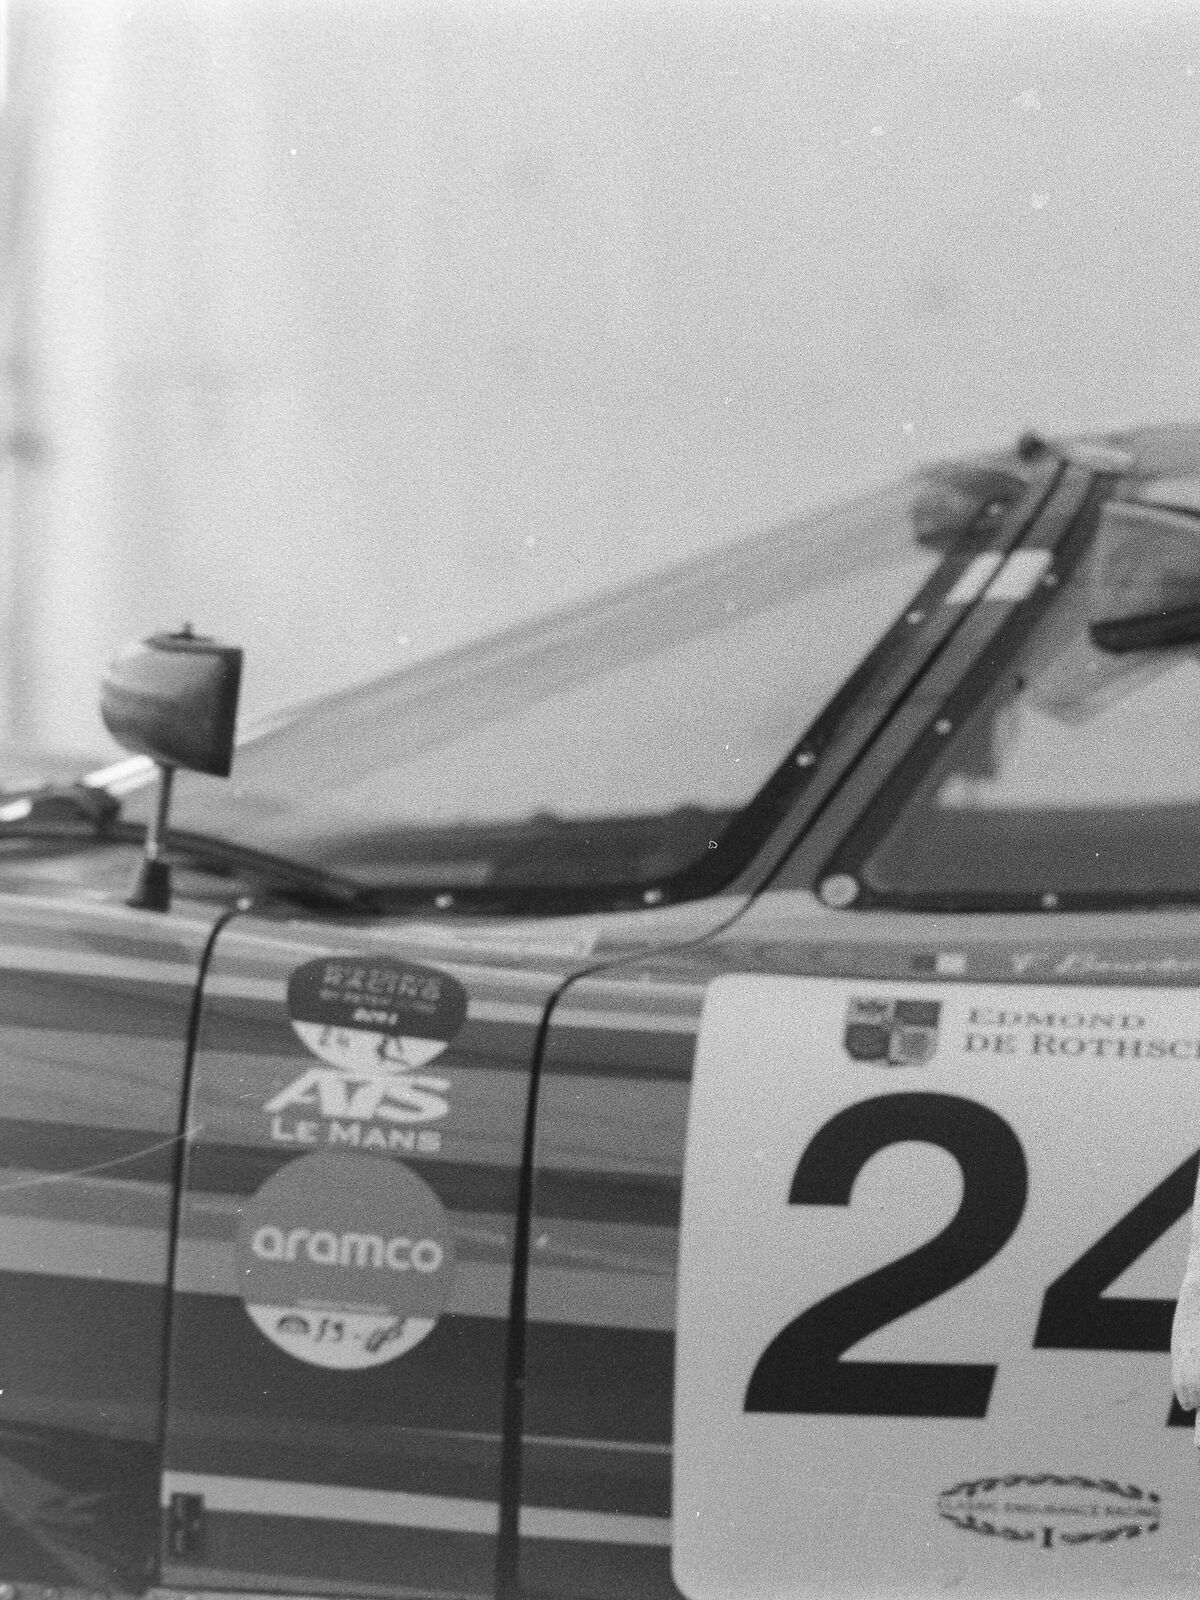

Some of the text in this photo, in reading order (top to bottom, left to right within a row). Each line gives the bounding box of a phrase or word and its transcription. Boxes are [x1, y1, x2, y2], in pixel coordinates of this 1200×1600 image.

[967, 1007, 1147, 1030] EDMOND
[964, 1033, 1018, 1054] DE
[271, 1117, 441, 1152] LE MANS
[251, 1226, 444, 1274] aramco
